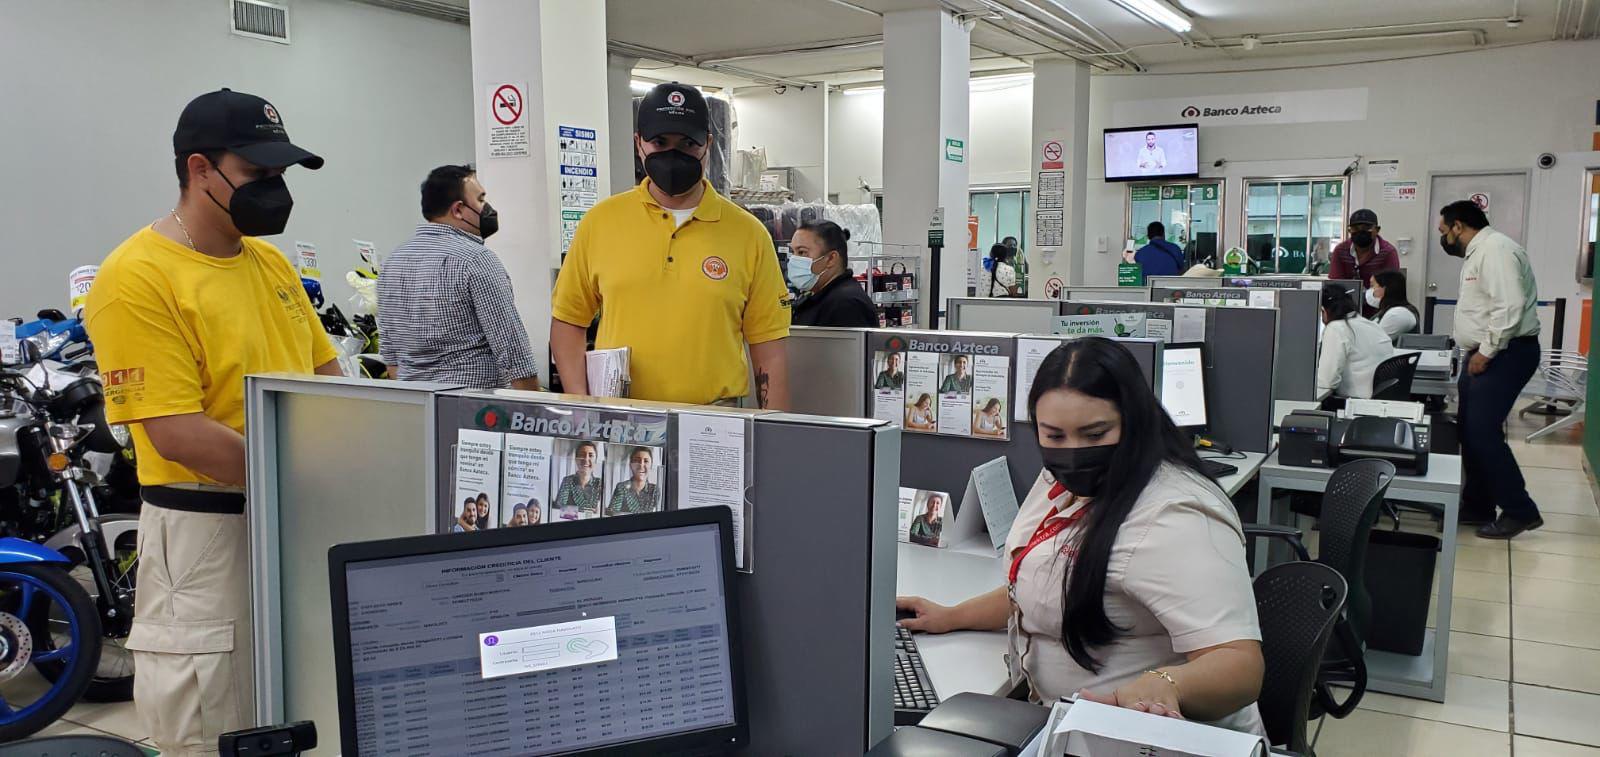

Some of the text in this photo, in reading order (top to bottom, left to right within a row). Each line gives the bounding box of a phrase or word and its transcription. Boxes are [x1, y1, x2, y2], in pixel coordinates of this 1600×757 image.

[1203, 105, 1282, 117] Banco Azteca
[575, 129, 594, 139] SISMO
[564, 166, 594, 176] INCENDIO
[1206, 187, 1214, 199] 3
[1329, 184, 1337, 196] 4
[1185, 290, 1241, 299] Banco Azteca
[1069, 319, 1100, 327] inversión
[1076, 326, 1086, 334] da
[909, 339, 999, 355] Banco Azteca
[511, 411, 646, 443] Banco Azteca
